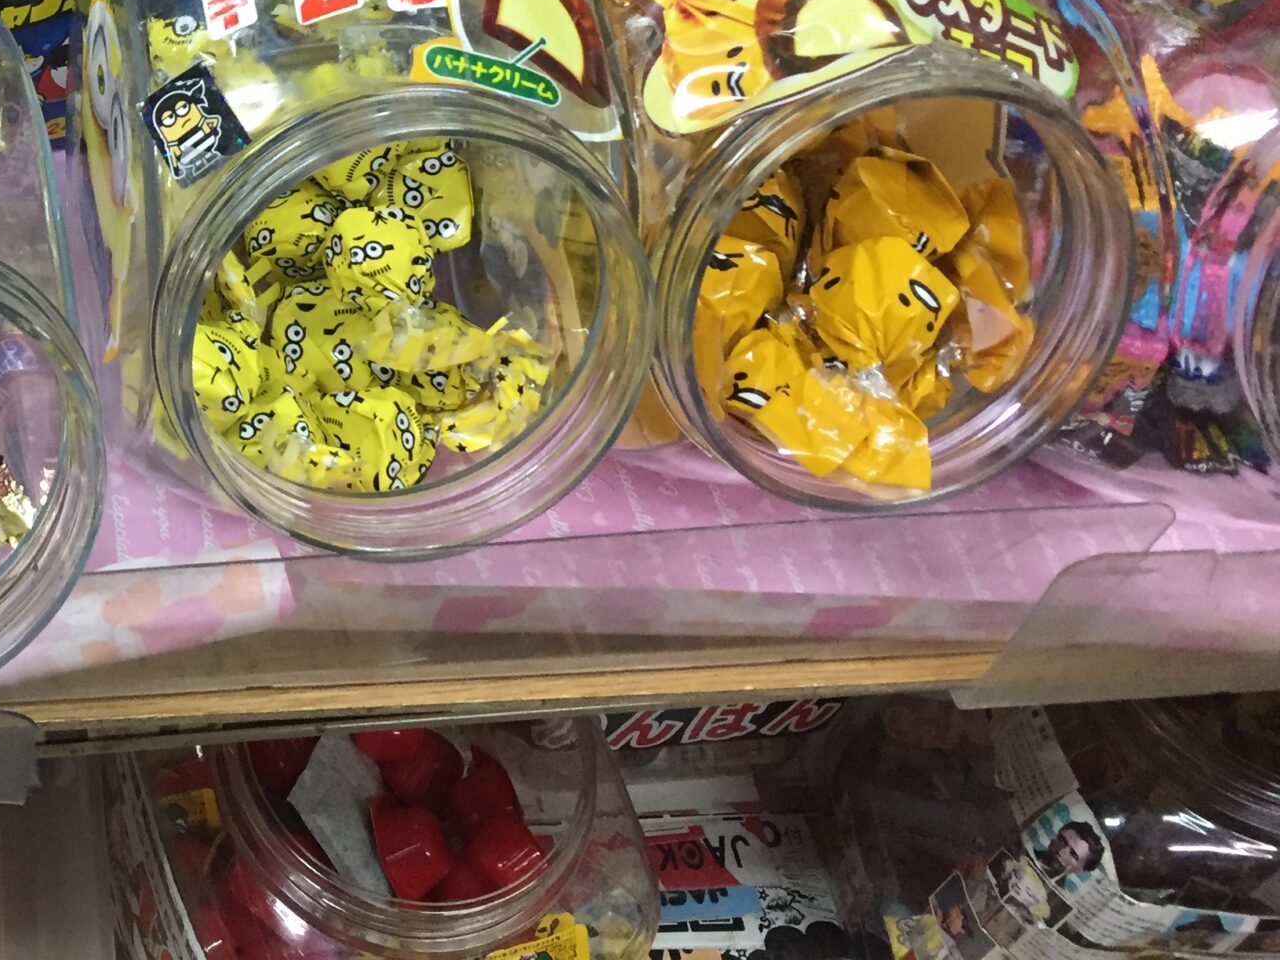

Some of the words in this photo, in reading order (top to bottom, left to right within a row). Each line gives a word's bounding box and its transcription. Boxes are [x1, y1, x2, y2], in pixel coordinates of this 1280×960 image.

[434, 55, 553, 101] バナナクリーム
